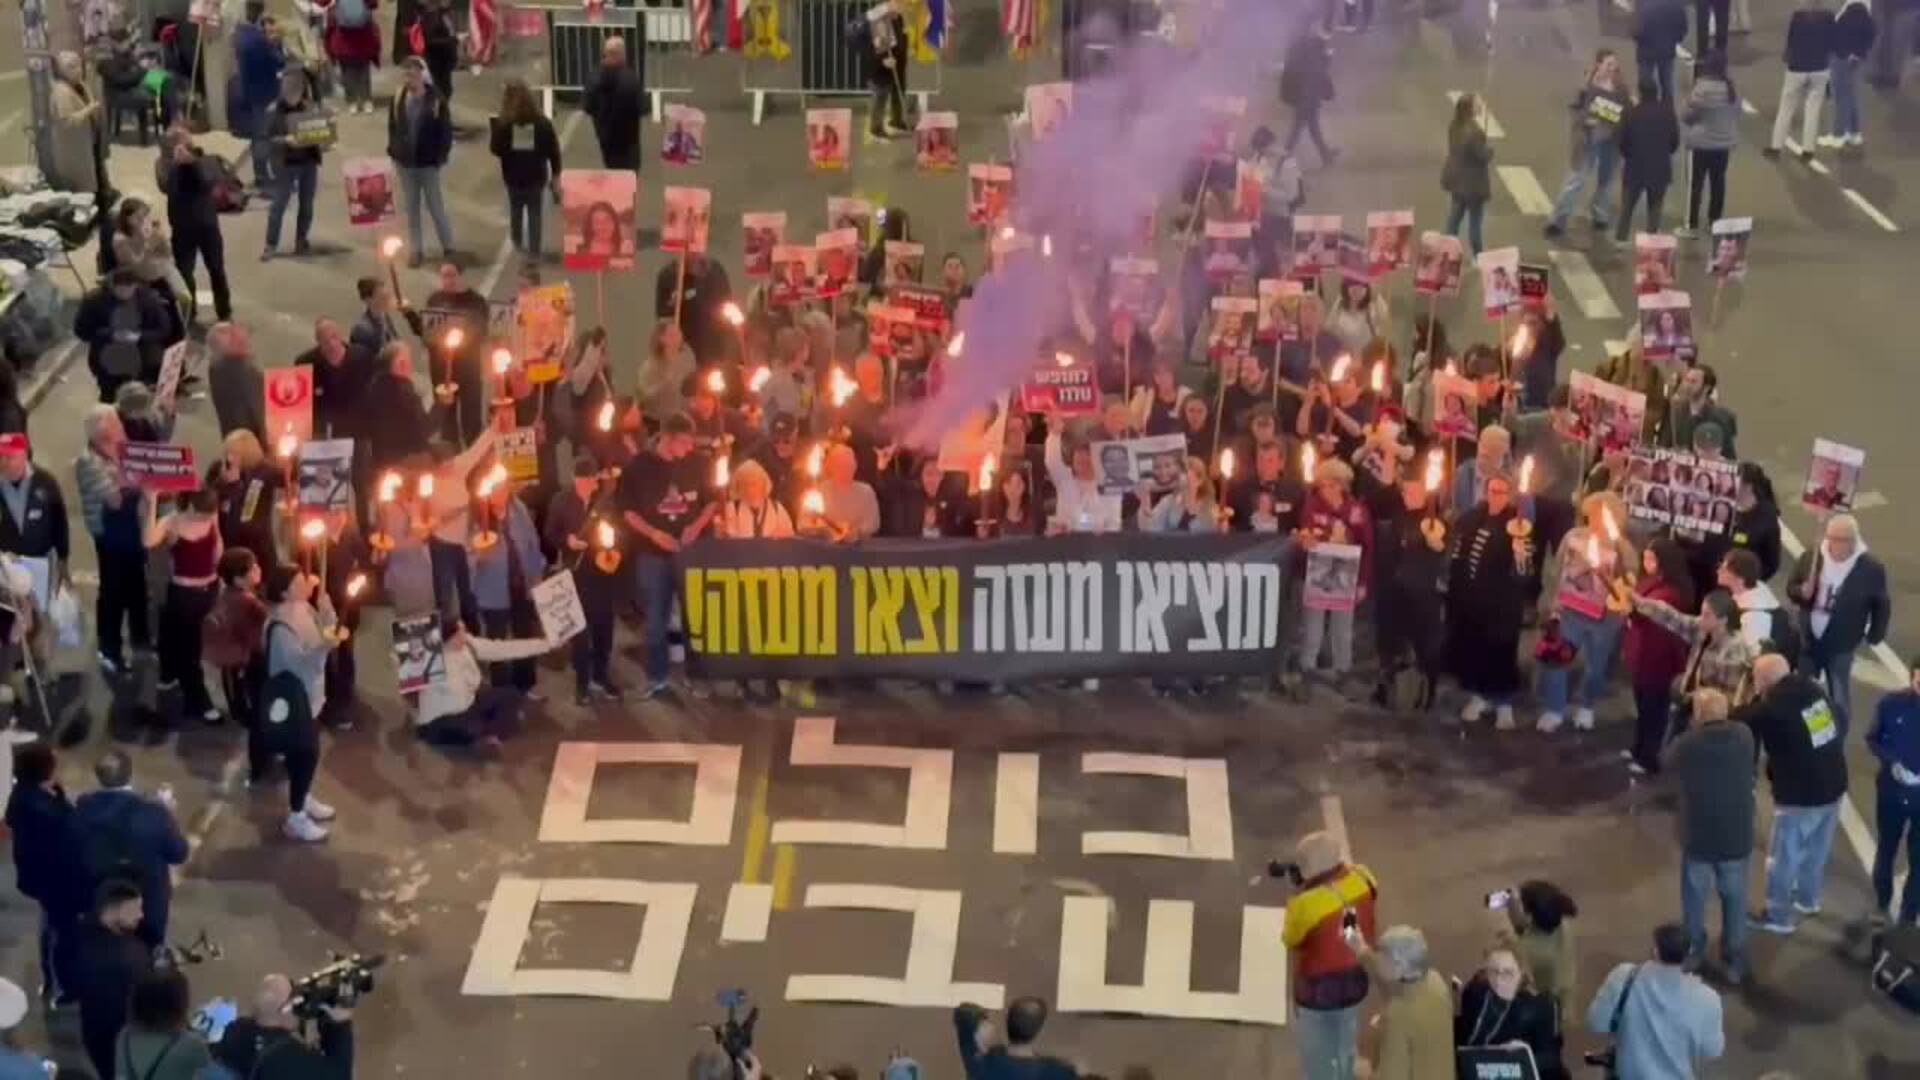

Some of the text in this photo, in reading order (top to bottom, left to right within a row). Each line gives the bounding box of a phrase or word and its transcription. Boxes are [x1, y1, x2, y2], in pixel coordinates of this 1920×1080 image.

[685, 565, 837, 655] מעזה!
[849, 566, 960, 654] וצאו
[973, 562, 1104, 652] מעזה
[1115, 561, 1281, 653] תוציאו
[538, 718, 1233, 862] כולם
[462, 878, 1288, 1025] שבים
